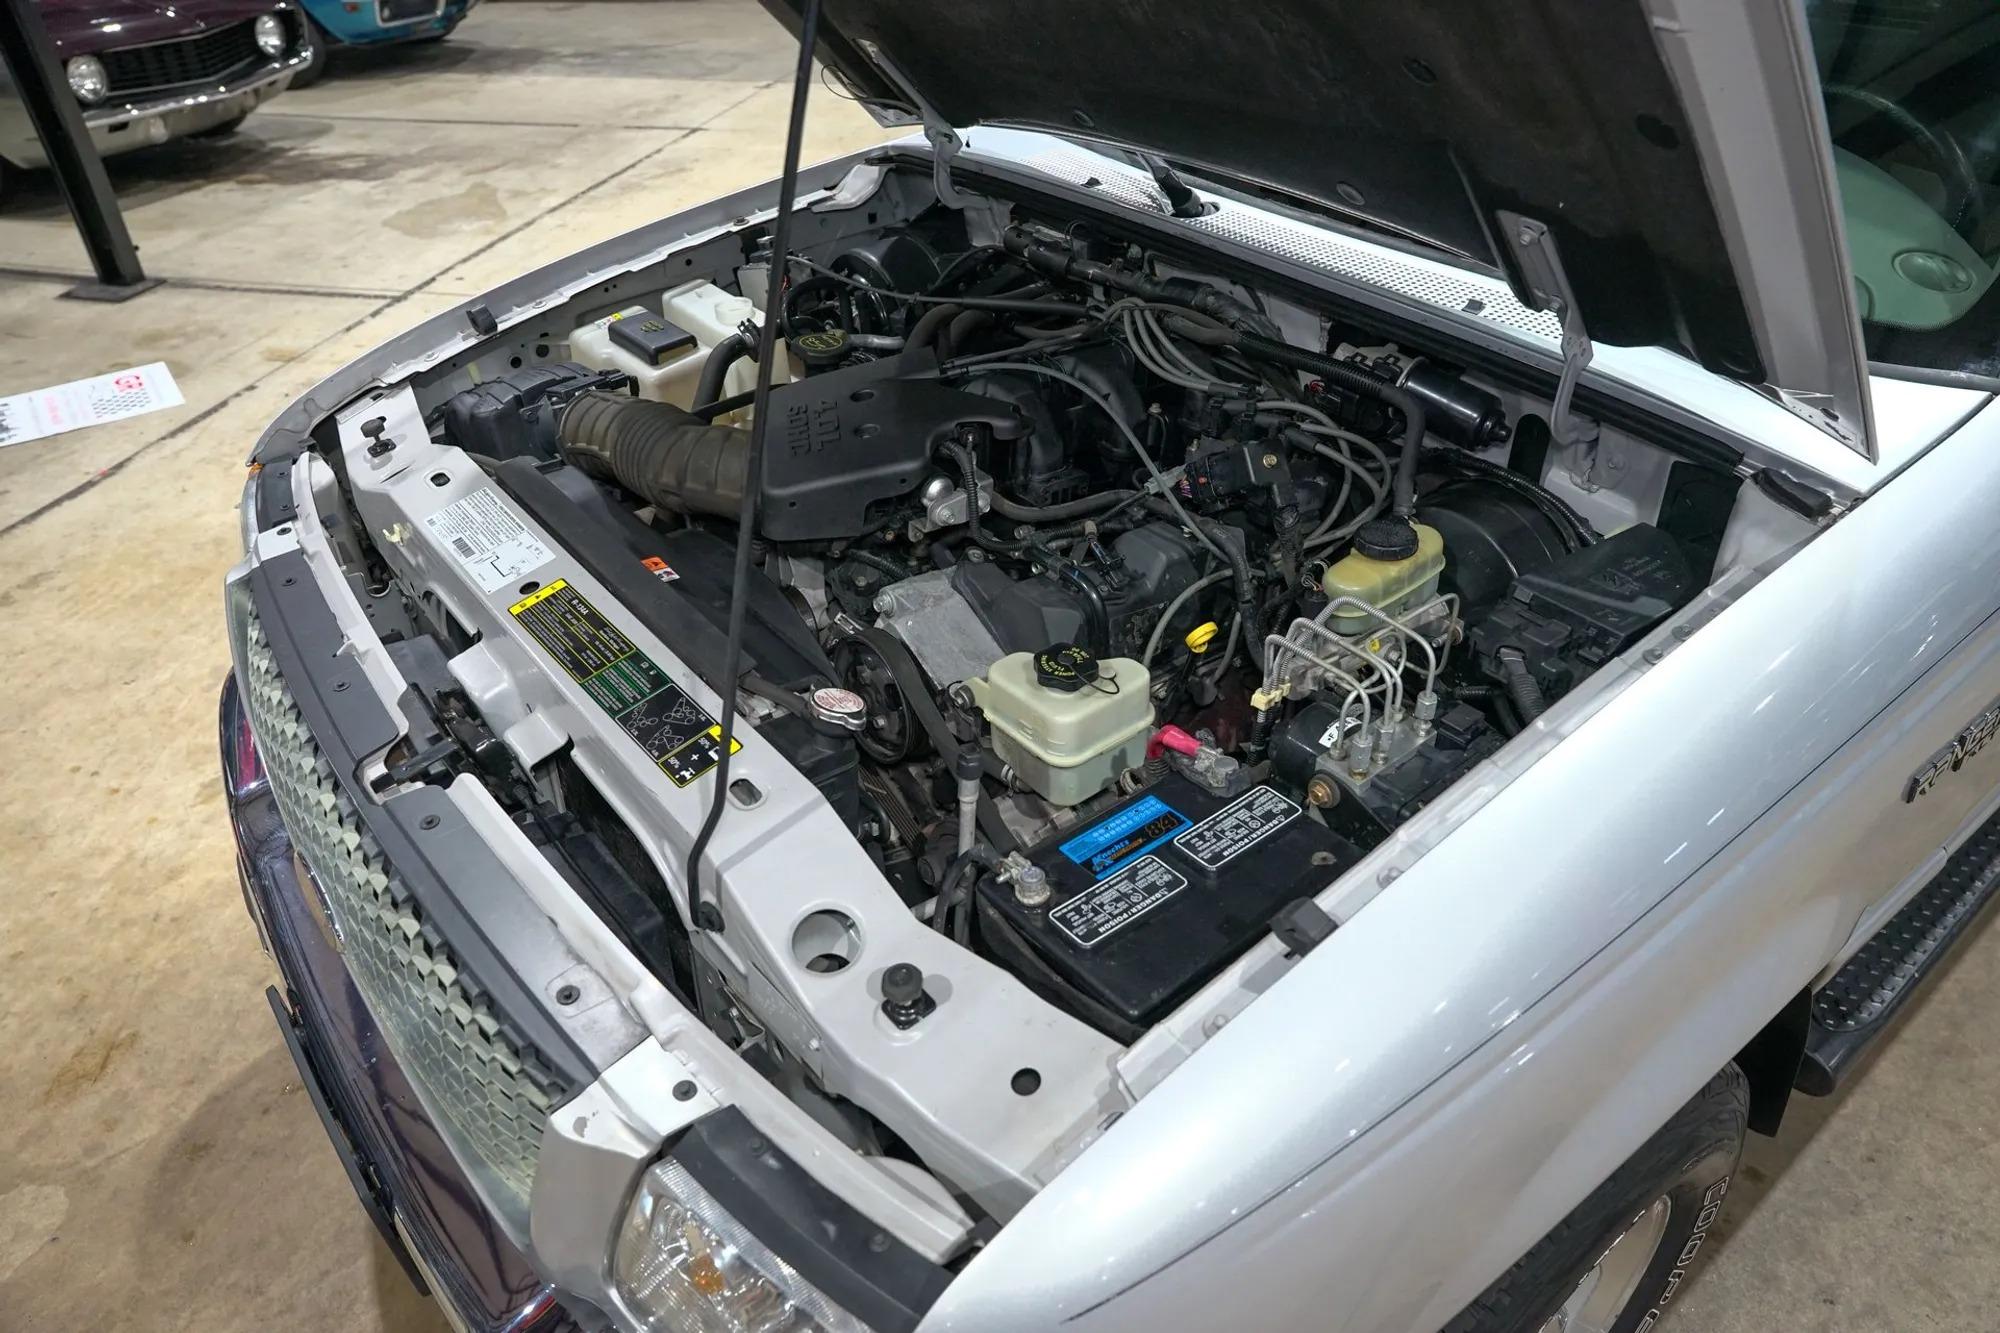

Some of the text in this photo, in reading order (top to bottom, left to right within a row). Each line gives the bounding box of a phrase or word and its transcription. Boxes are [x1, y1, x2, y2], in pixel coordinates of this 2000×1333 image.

[786, 404, 810, 456] SOHC
[698, 736, 710, 748] 50%
[668, 756, 680, 768] 50%
